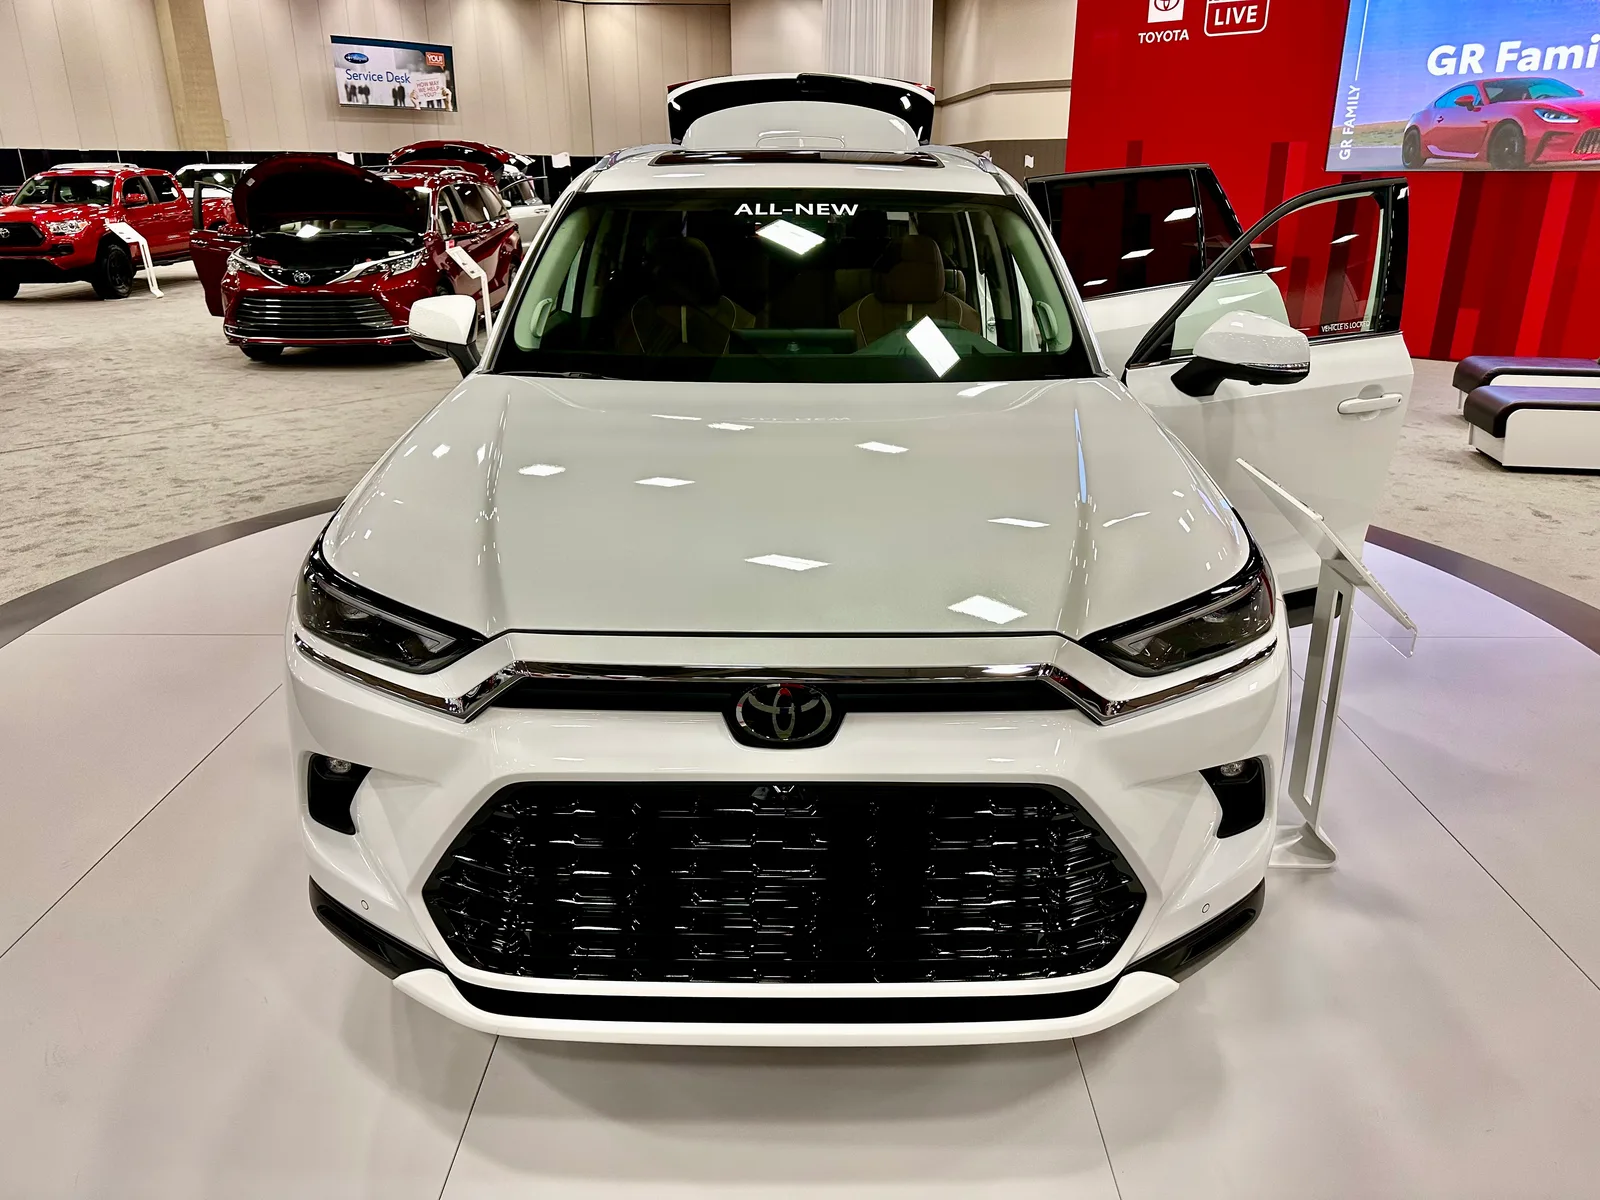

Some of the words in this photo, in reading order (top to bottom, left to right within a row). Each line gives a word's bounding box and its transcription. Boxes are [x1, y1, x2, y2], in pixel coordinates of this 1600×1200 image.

[1214, 4, 1258, 26] LIVE
[1138, 28, 1190, 44] TOYOTA
[1427, 42, 1485, 76] GR
[345, 68, 383, 83] Service
[386, 72, 411, 84] Desk
[1342, 85, 1361, 135] FAMILY
[1338, 138, 1353, 161] GR
[734, 203, 859, 216] ALL-NEW
